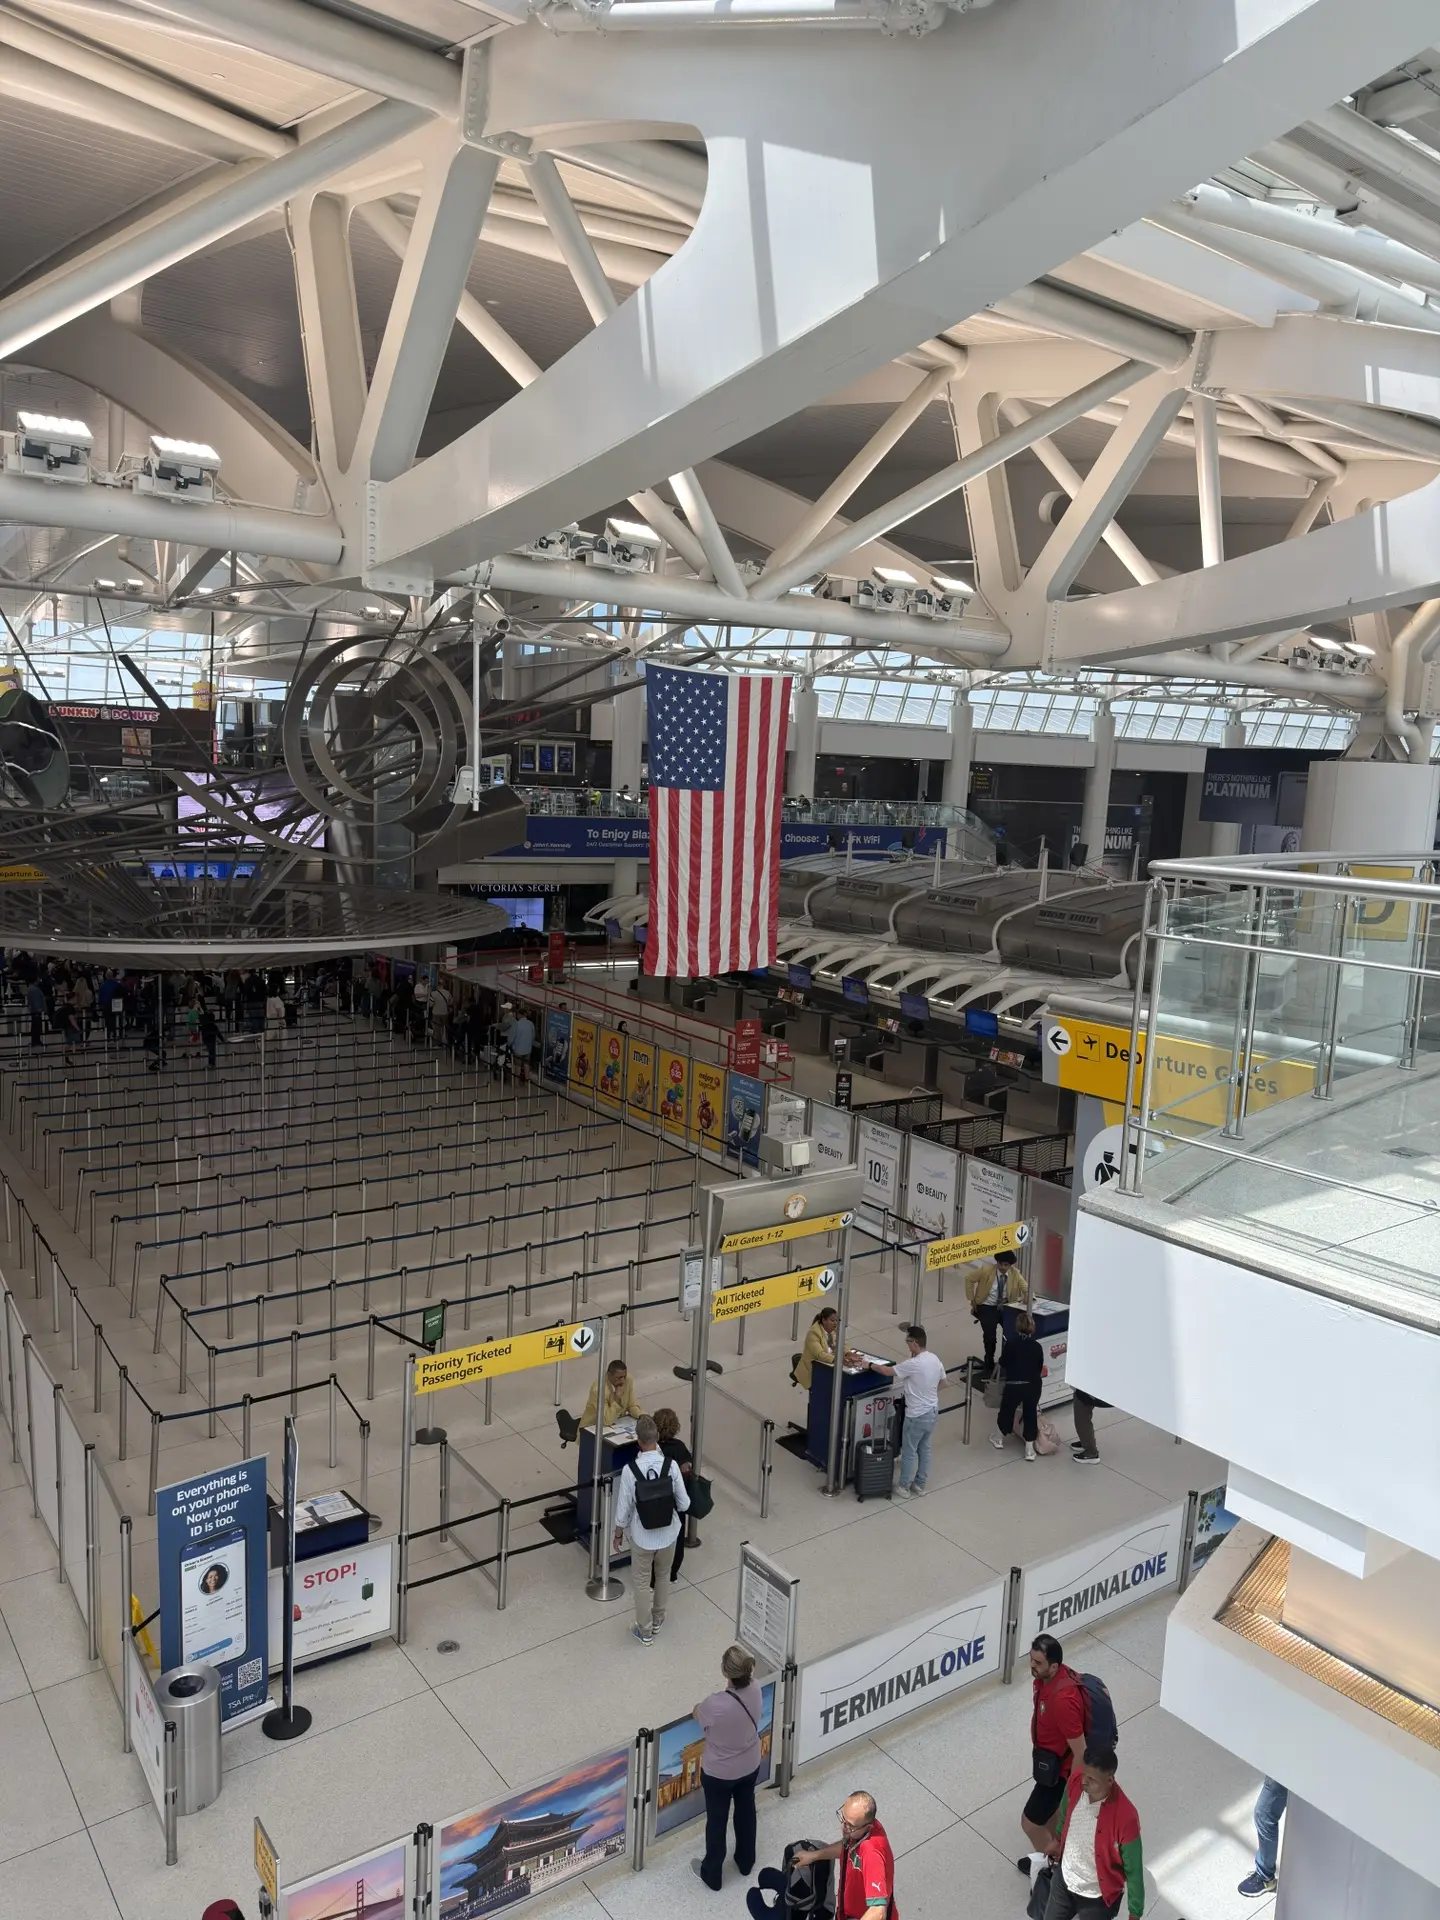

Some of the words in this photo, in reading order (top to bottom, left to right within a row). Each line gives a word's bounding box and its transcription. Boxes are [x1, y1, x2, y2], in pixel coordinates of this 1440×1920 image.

[112, 710, 160, 722] DONUTS
[1204, 782, 1272, 799] PLATINUM
[587, 829, 600, 839] To
[602, 829, 629, 841] Enjoy
[785, 833, 819, 843] Choose:
[469, 884, 523, 892] VICTORIA'S
[527, 884, 561, 892] SECRET
[824, 1146, 843, 1160] BEAUTY
[987, 1170, 1004, 1182] BEAUTY
[925, 1186, 947, 1202] BEAUTY
[725, 1235, 738, 1248] All
[740, 1235, 764, 1246] Gates
[767, 1230, 784, 1240] 1-12
[930, 1243, 950, 1256] Special
[951, 1238, 979, 1251] Assistance
[930, 1254, 946, 1267] Flight
[947, 1252, 961, 1262] Crew
[968, 1243, 997, 1257] Employees
[716, 1295, 728, 1306] All
[730, 1286, 765, 1303] Ticketed
[715, 1300, 761, 1318] Passengers
[422, 1356, 463, 1374] Priority
[466, 1344, 512, 1364] Ticketed
[422, 1364, 483, 1387] Passengers
[177, 1474, 237, 1501] Everything
[238, 1470, 247, 1481] is
[172, 1505, 186, 1516] on
[188, 1495, 215, 1513] your
[216, 1483, 252, 1503] phone.
[186, 1509, 212, 1525] Now
[214, 1500, 239, 1517] your
[190, 1525, 202, 1537] ID
[205, 1522, 213, 1532] is
[215, 1516, 236, 1528] too.
[304, 1562, 356, 1589] STOP!
[228, 1700, 241, 1710] TSA
